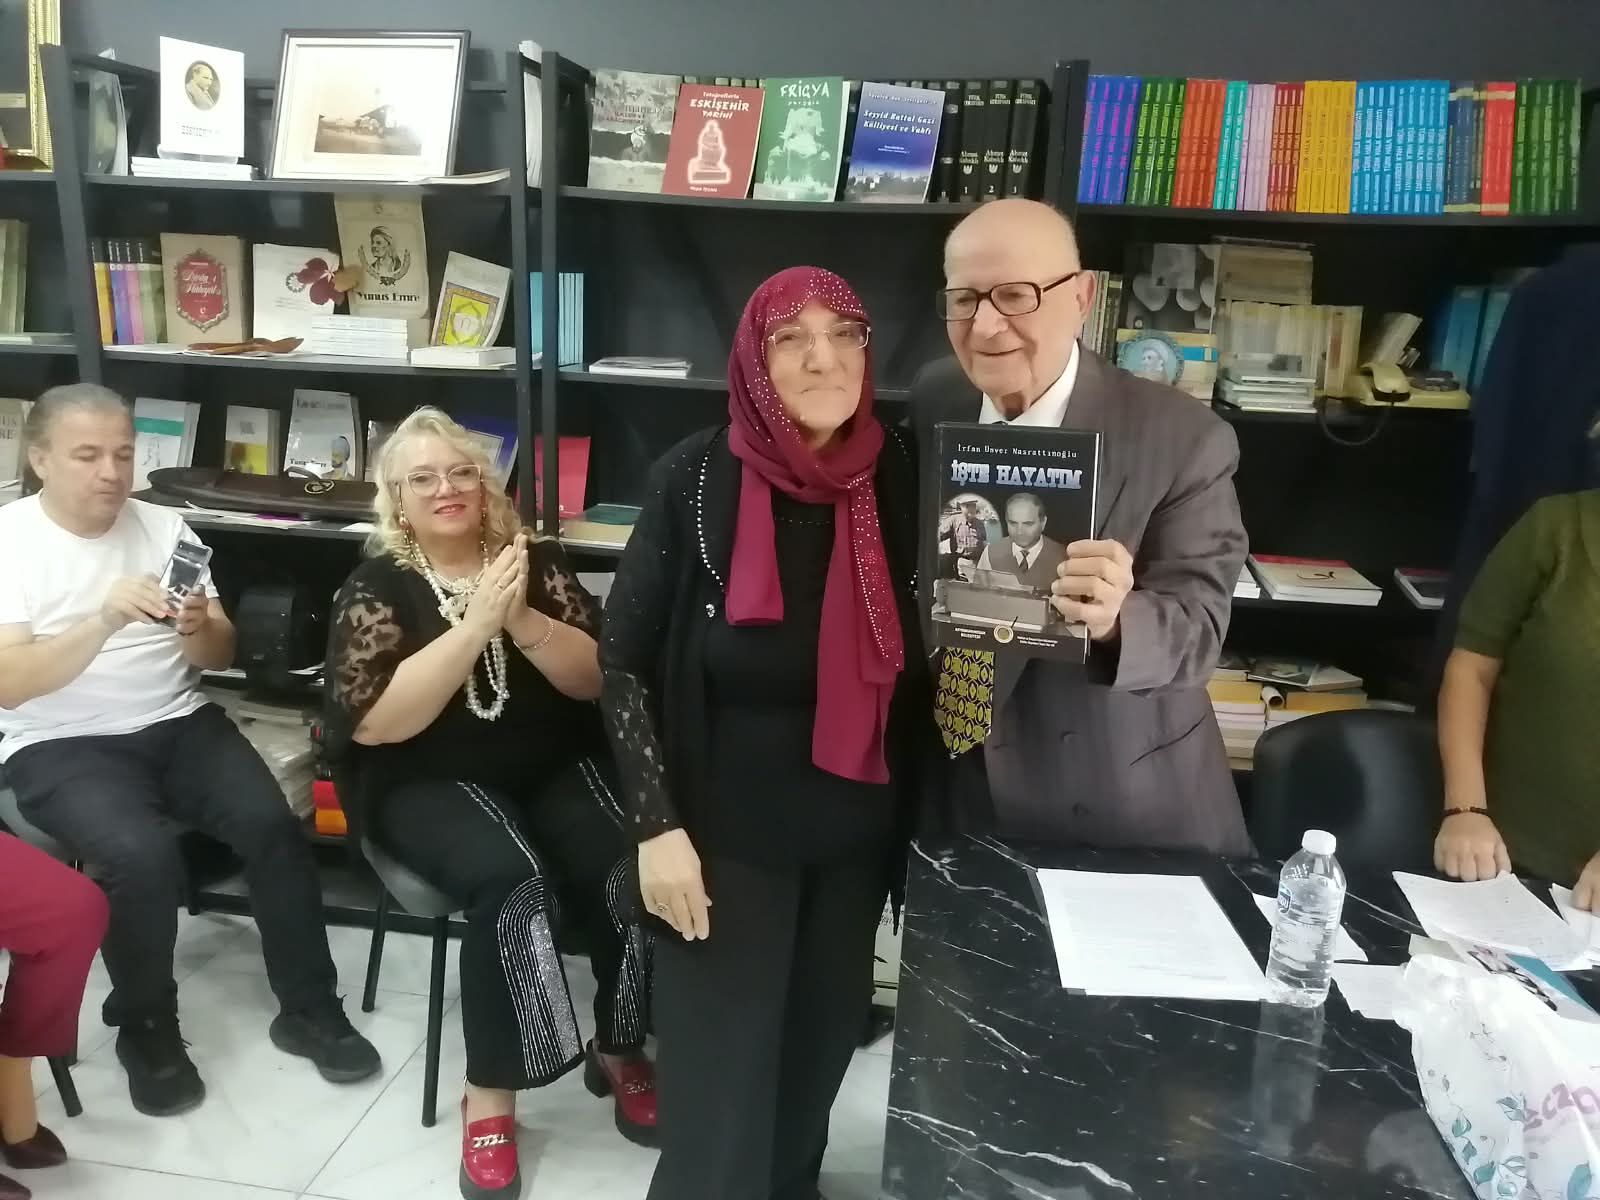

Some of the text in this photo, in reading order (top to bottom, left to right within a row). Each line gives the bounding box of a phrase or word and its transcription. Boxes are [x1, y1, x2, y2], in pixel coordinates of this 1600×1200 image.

[690, 98, 750, 112] ESKİŞEHİR
[890, 113, 916, 122] Battal
[989, 185, 995, 193] 2
[951, 459, 1083, 490] İŞTE HAYATIM
